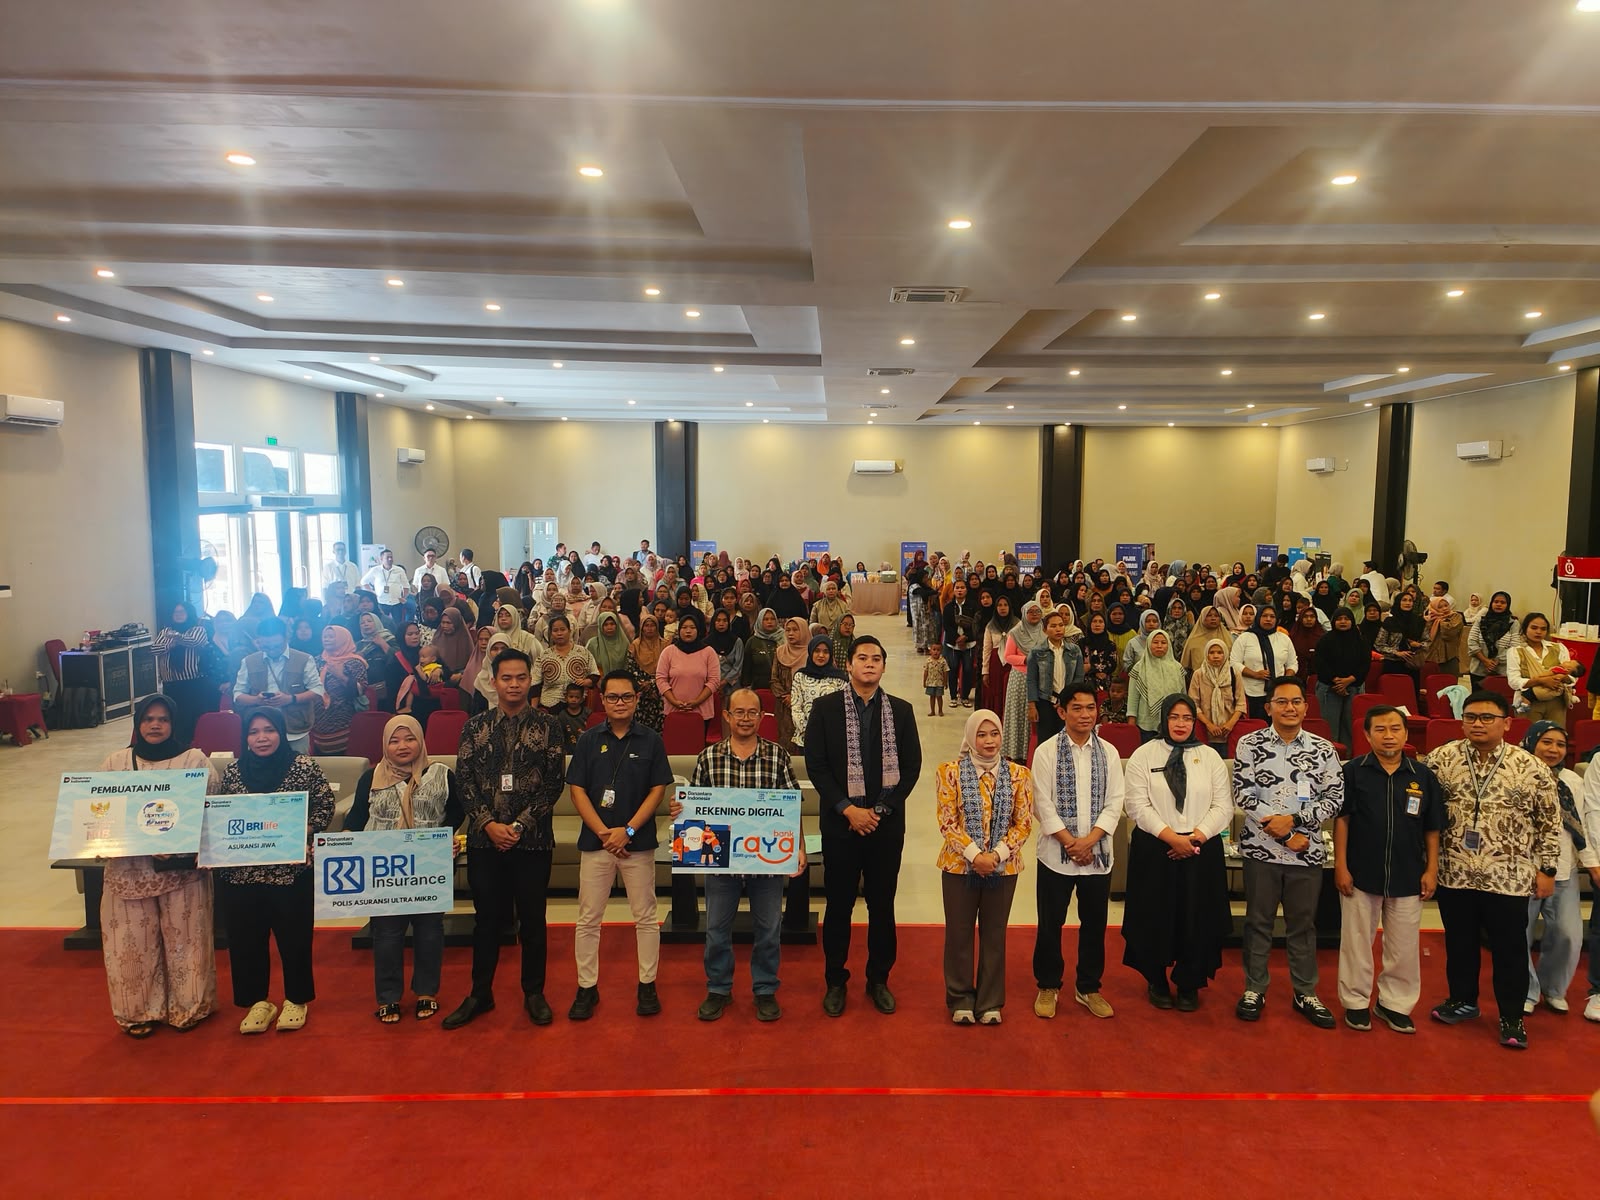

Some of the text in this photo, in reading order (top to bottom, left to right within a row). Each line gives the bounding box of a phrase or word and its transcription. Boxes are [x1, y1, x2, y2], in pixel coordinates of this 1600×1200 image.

[91, 783, 171, 794] PEMBUATAN NIB
[695, 806, 785, 817] REKENING DIGITAL
[732, 836, 795, 853] raya
[371, 854, 415, 878] BRI
[372, 875, 446, 889] Insurance
[354, 898, 390, 906] ASURANSI
